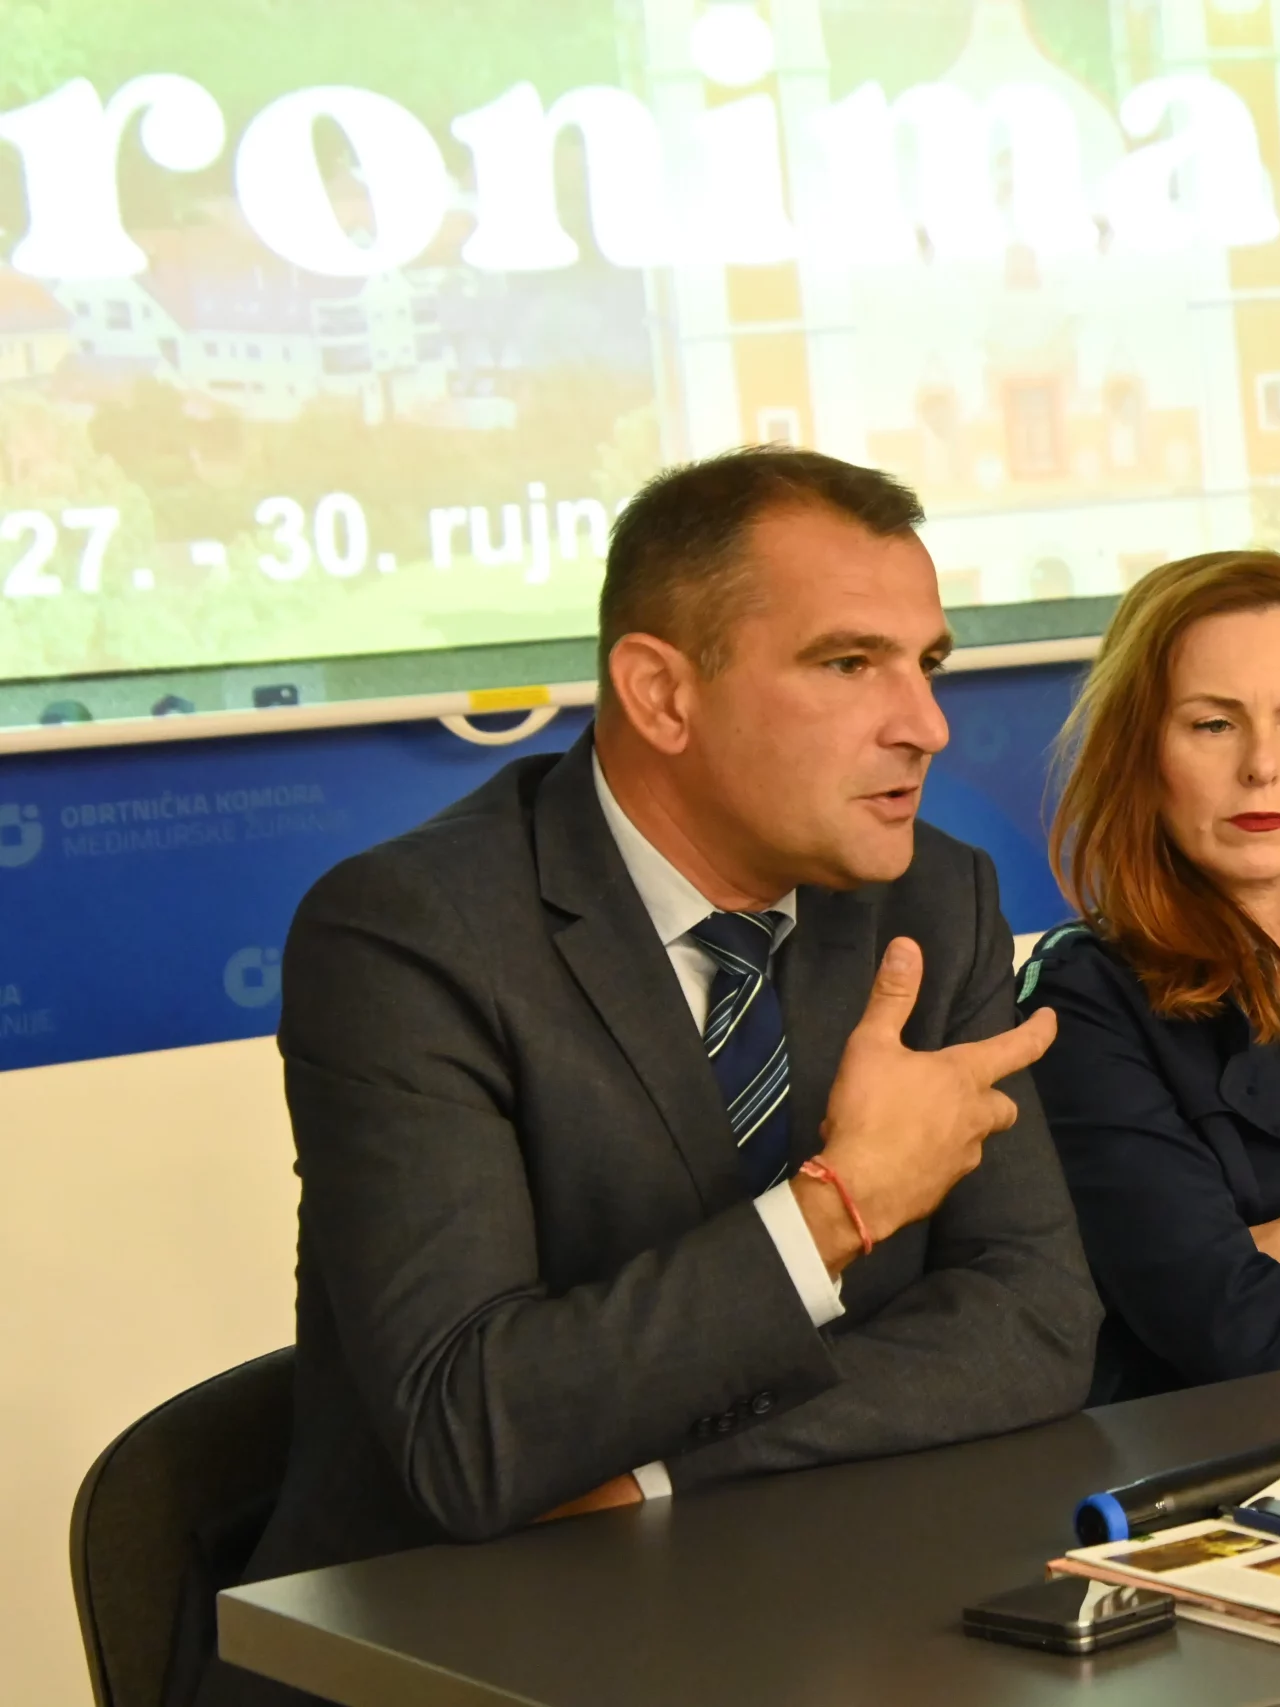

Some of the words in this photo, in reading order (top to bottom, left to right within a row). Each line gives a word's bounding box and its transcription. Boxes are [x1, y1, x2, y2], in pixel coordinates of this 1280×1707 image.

[0, 506, 155, 598] 27.
[254, 491, 397, 581] 30.
[429, 481, 637, 584] rujn
[61, 790, 209, 829] OBRTNIČKA
[216, 784, 325, 814] KOMORA
